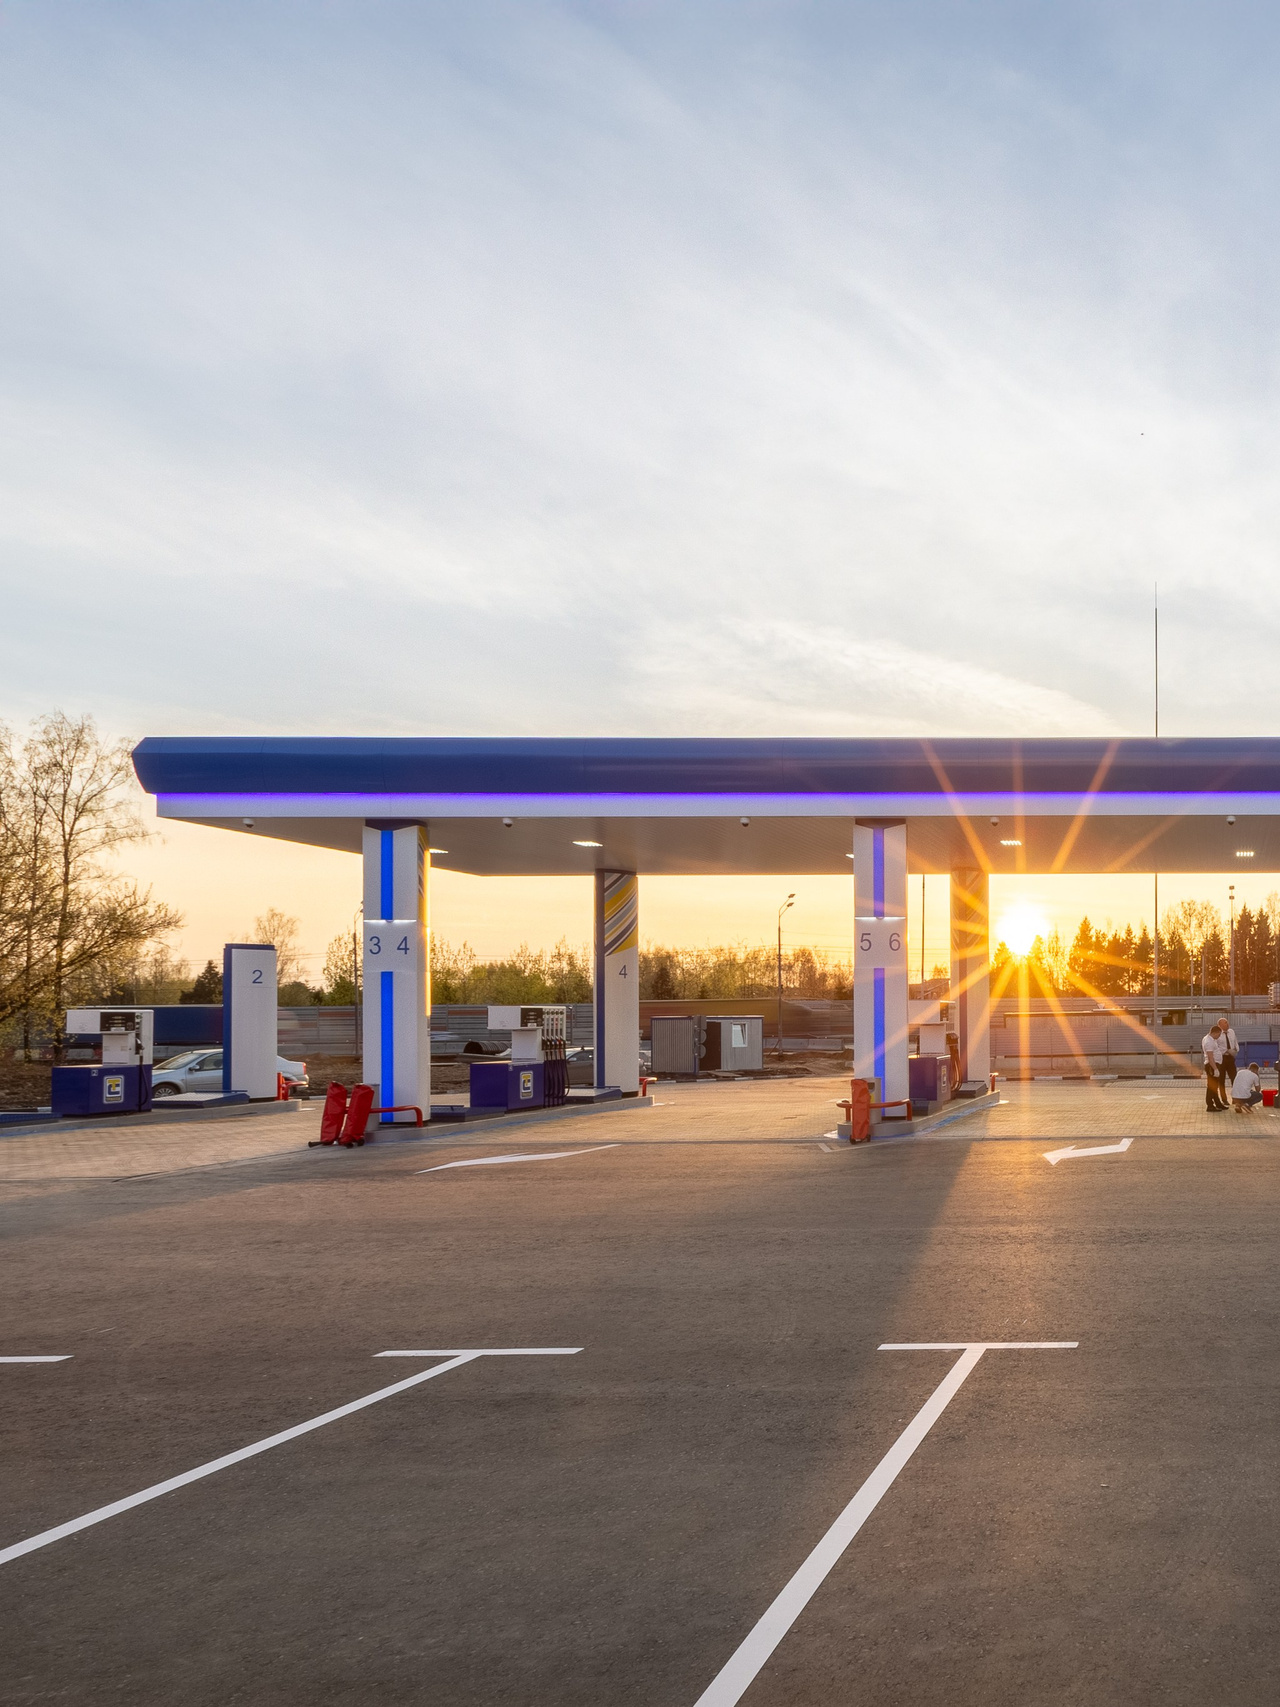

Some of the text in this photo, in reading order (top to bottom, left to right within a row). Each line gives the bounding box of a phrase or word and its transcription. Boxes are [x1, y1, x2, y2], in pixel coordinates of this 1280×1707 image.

[370, 936, 409, 955] 3 4
[860, 933, 900, 952] 5 6
[252, 970, 263, 983] 2
[619, 965, 628, 978] 4
